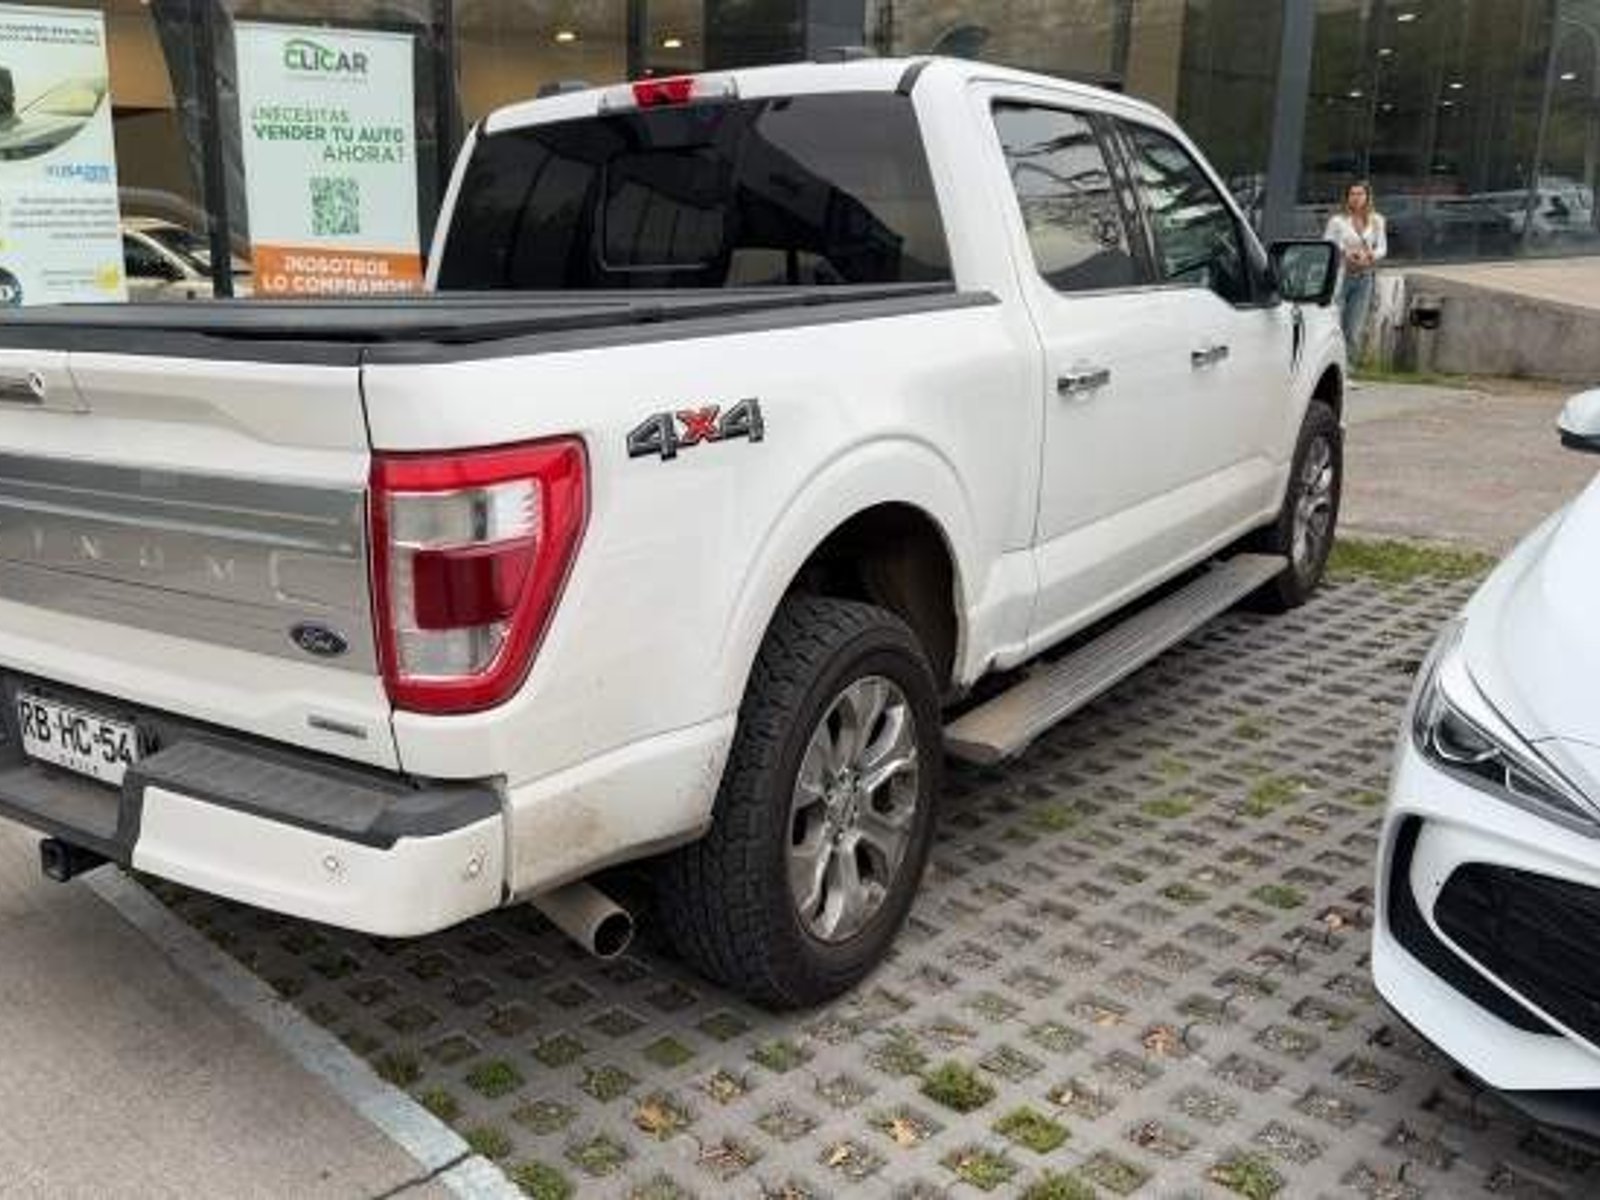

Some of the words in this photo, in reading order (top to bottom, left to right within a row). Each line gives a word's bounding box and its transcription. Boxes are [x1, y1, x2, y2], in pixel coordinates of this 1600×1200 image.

[283, 47, 369, 73] CLICAR
[253, 124, 326, 141] VENDER
[331, 127, 354, 142] TU
[358, 127, 404, 144] AUTO
[261, 273, 288, 291] LO
